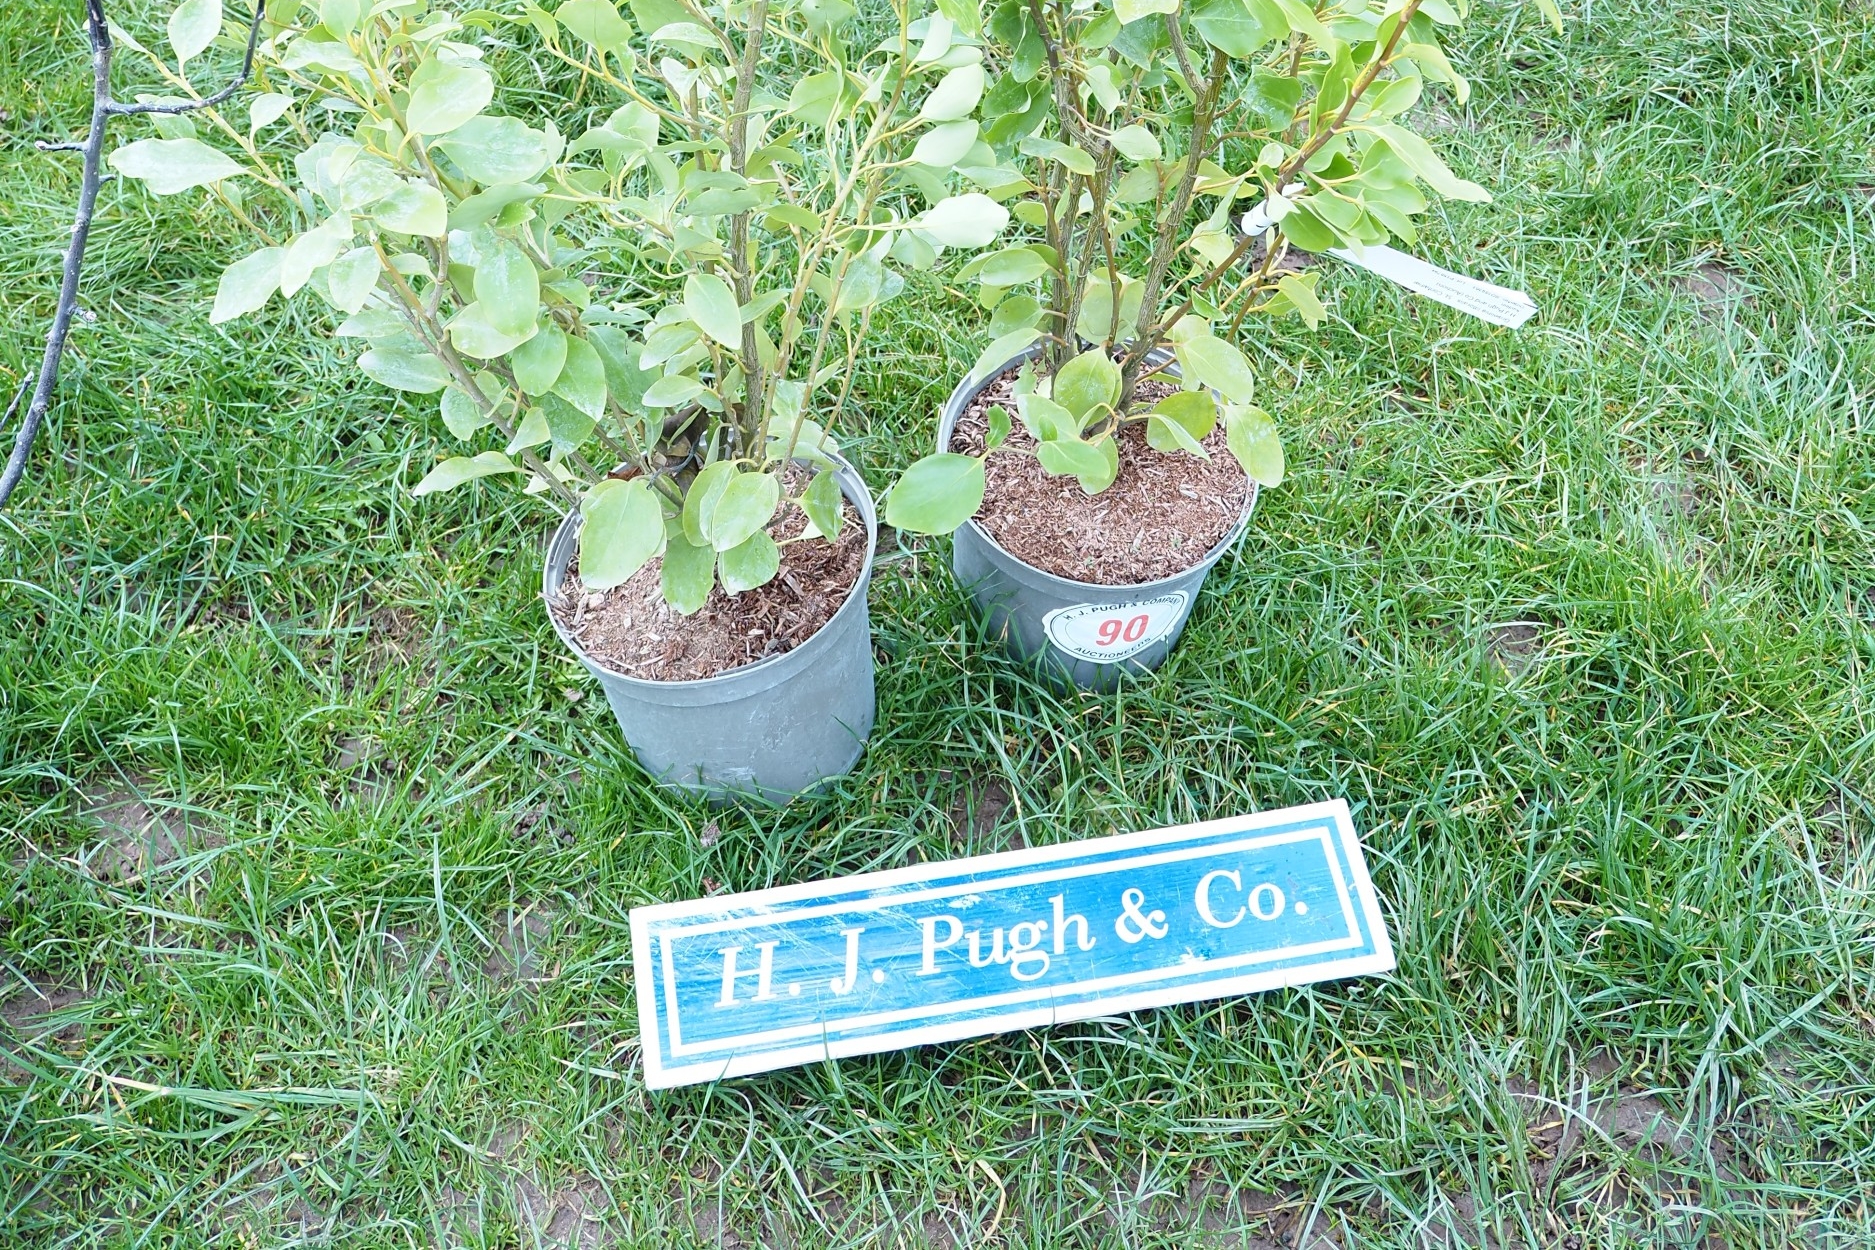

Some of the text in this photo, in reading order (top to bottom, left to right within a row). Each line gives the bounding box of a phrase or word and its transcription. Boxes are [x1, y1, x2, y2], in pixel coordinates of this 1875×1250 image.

[1091, 603, 1127, 613] PUGH
[1095, 614, 1149, 646] 90
[714, 869, 1308, 1008] H. J. Pugh & Co.
